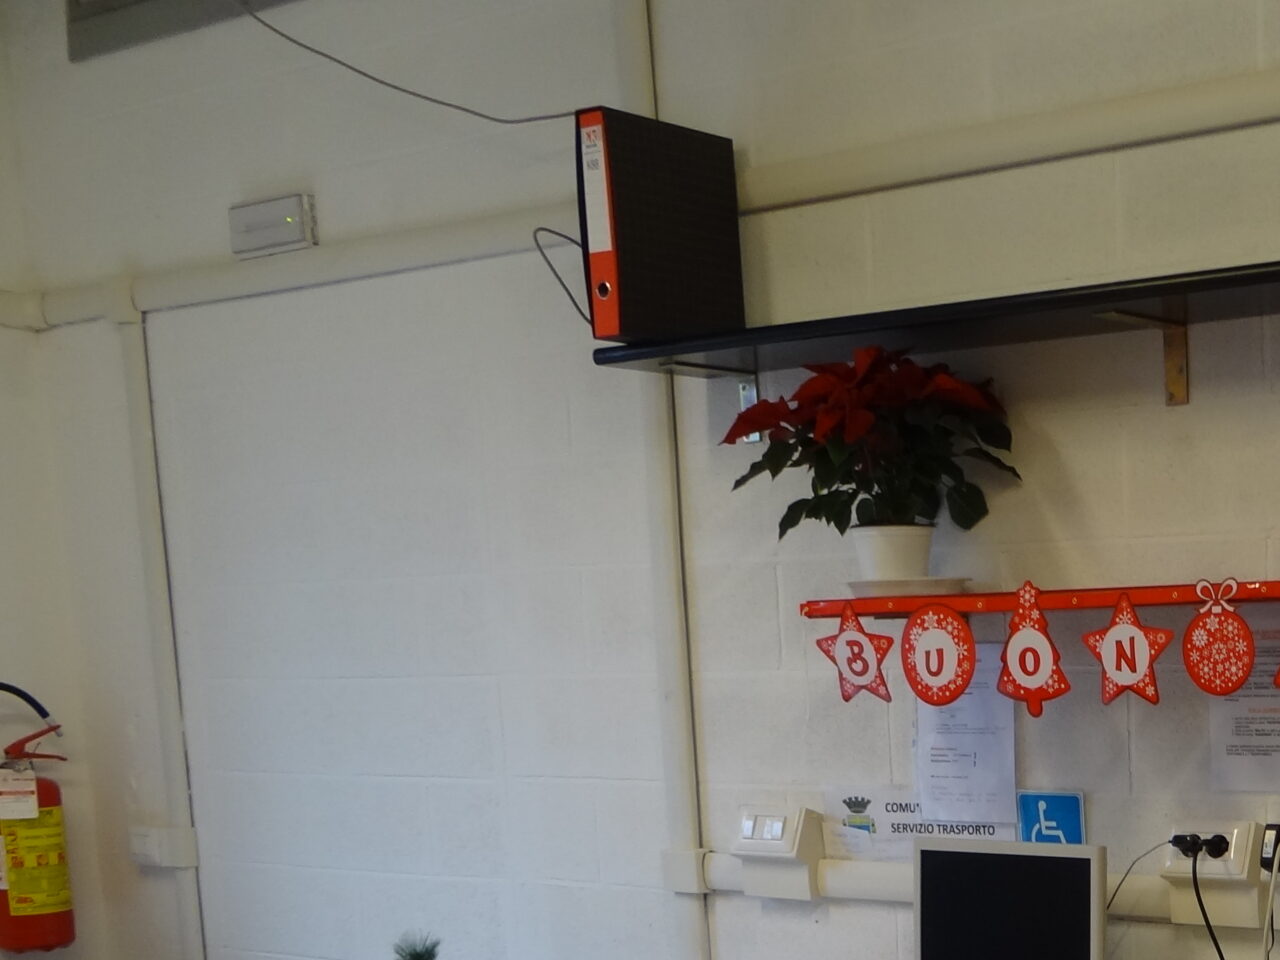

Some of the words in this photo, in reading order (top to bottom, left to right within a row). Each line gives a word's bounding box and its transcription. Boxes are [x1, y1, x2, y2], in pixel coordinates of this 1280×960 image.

[846, 636, 1138, 678] BUON
[885, 802, 921, 814] COMU
[890, 823, 935, 834] SERVIZIO
[936, 824, 996, 836] TRASPORTO
